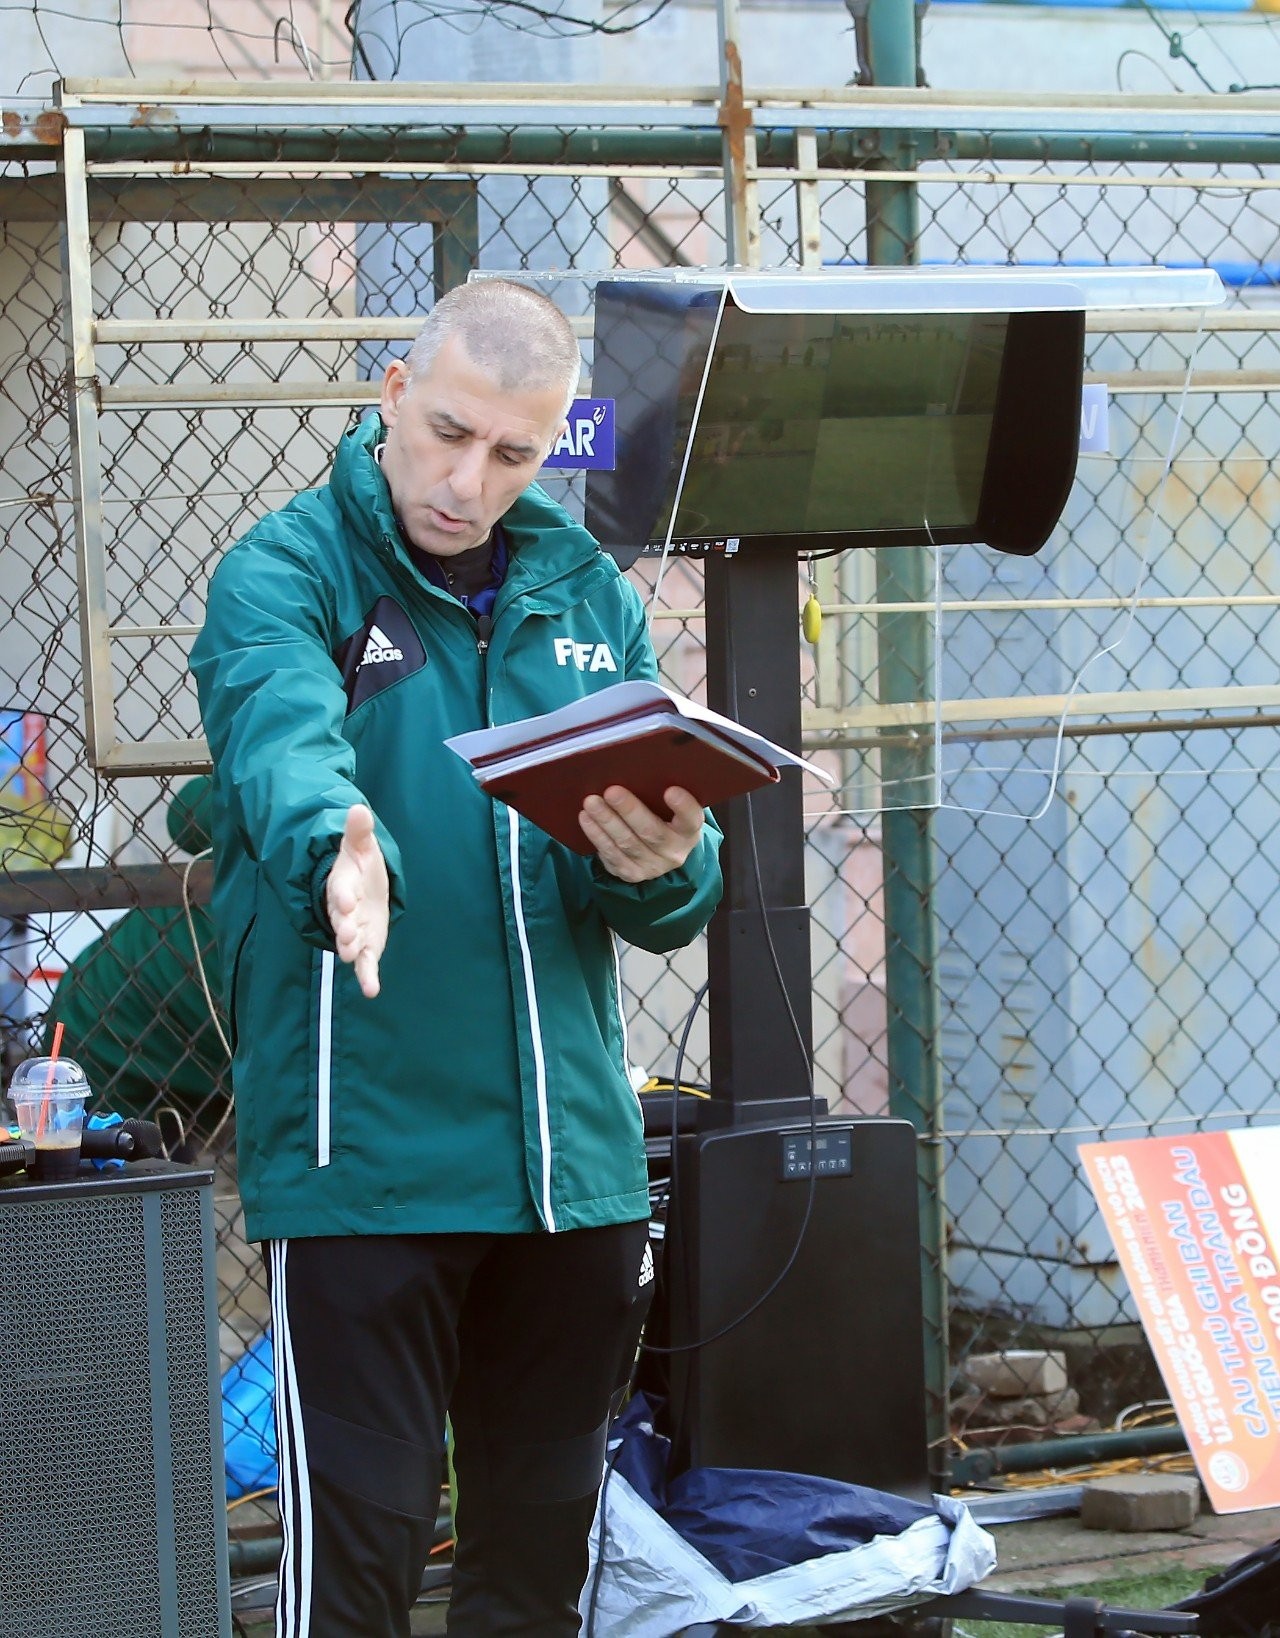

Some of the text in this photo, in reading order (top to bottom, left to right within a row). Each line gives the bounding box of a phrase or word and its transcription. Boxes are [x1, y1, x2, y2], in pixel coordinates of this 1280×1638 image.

[549, 419, 595, 457] AR
[356, 648, 404, 673] didas
[554, 637, 617, 672] FIFA
[1186, 1266, 1222, 1311] GHI
